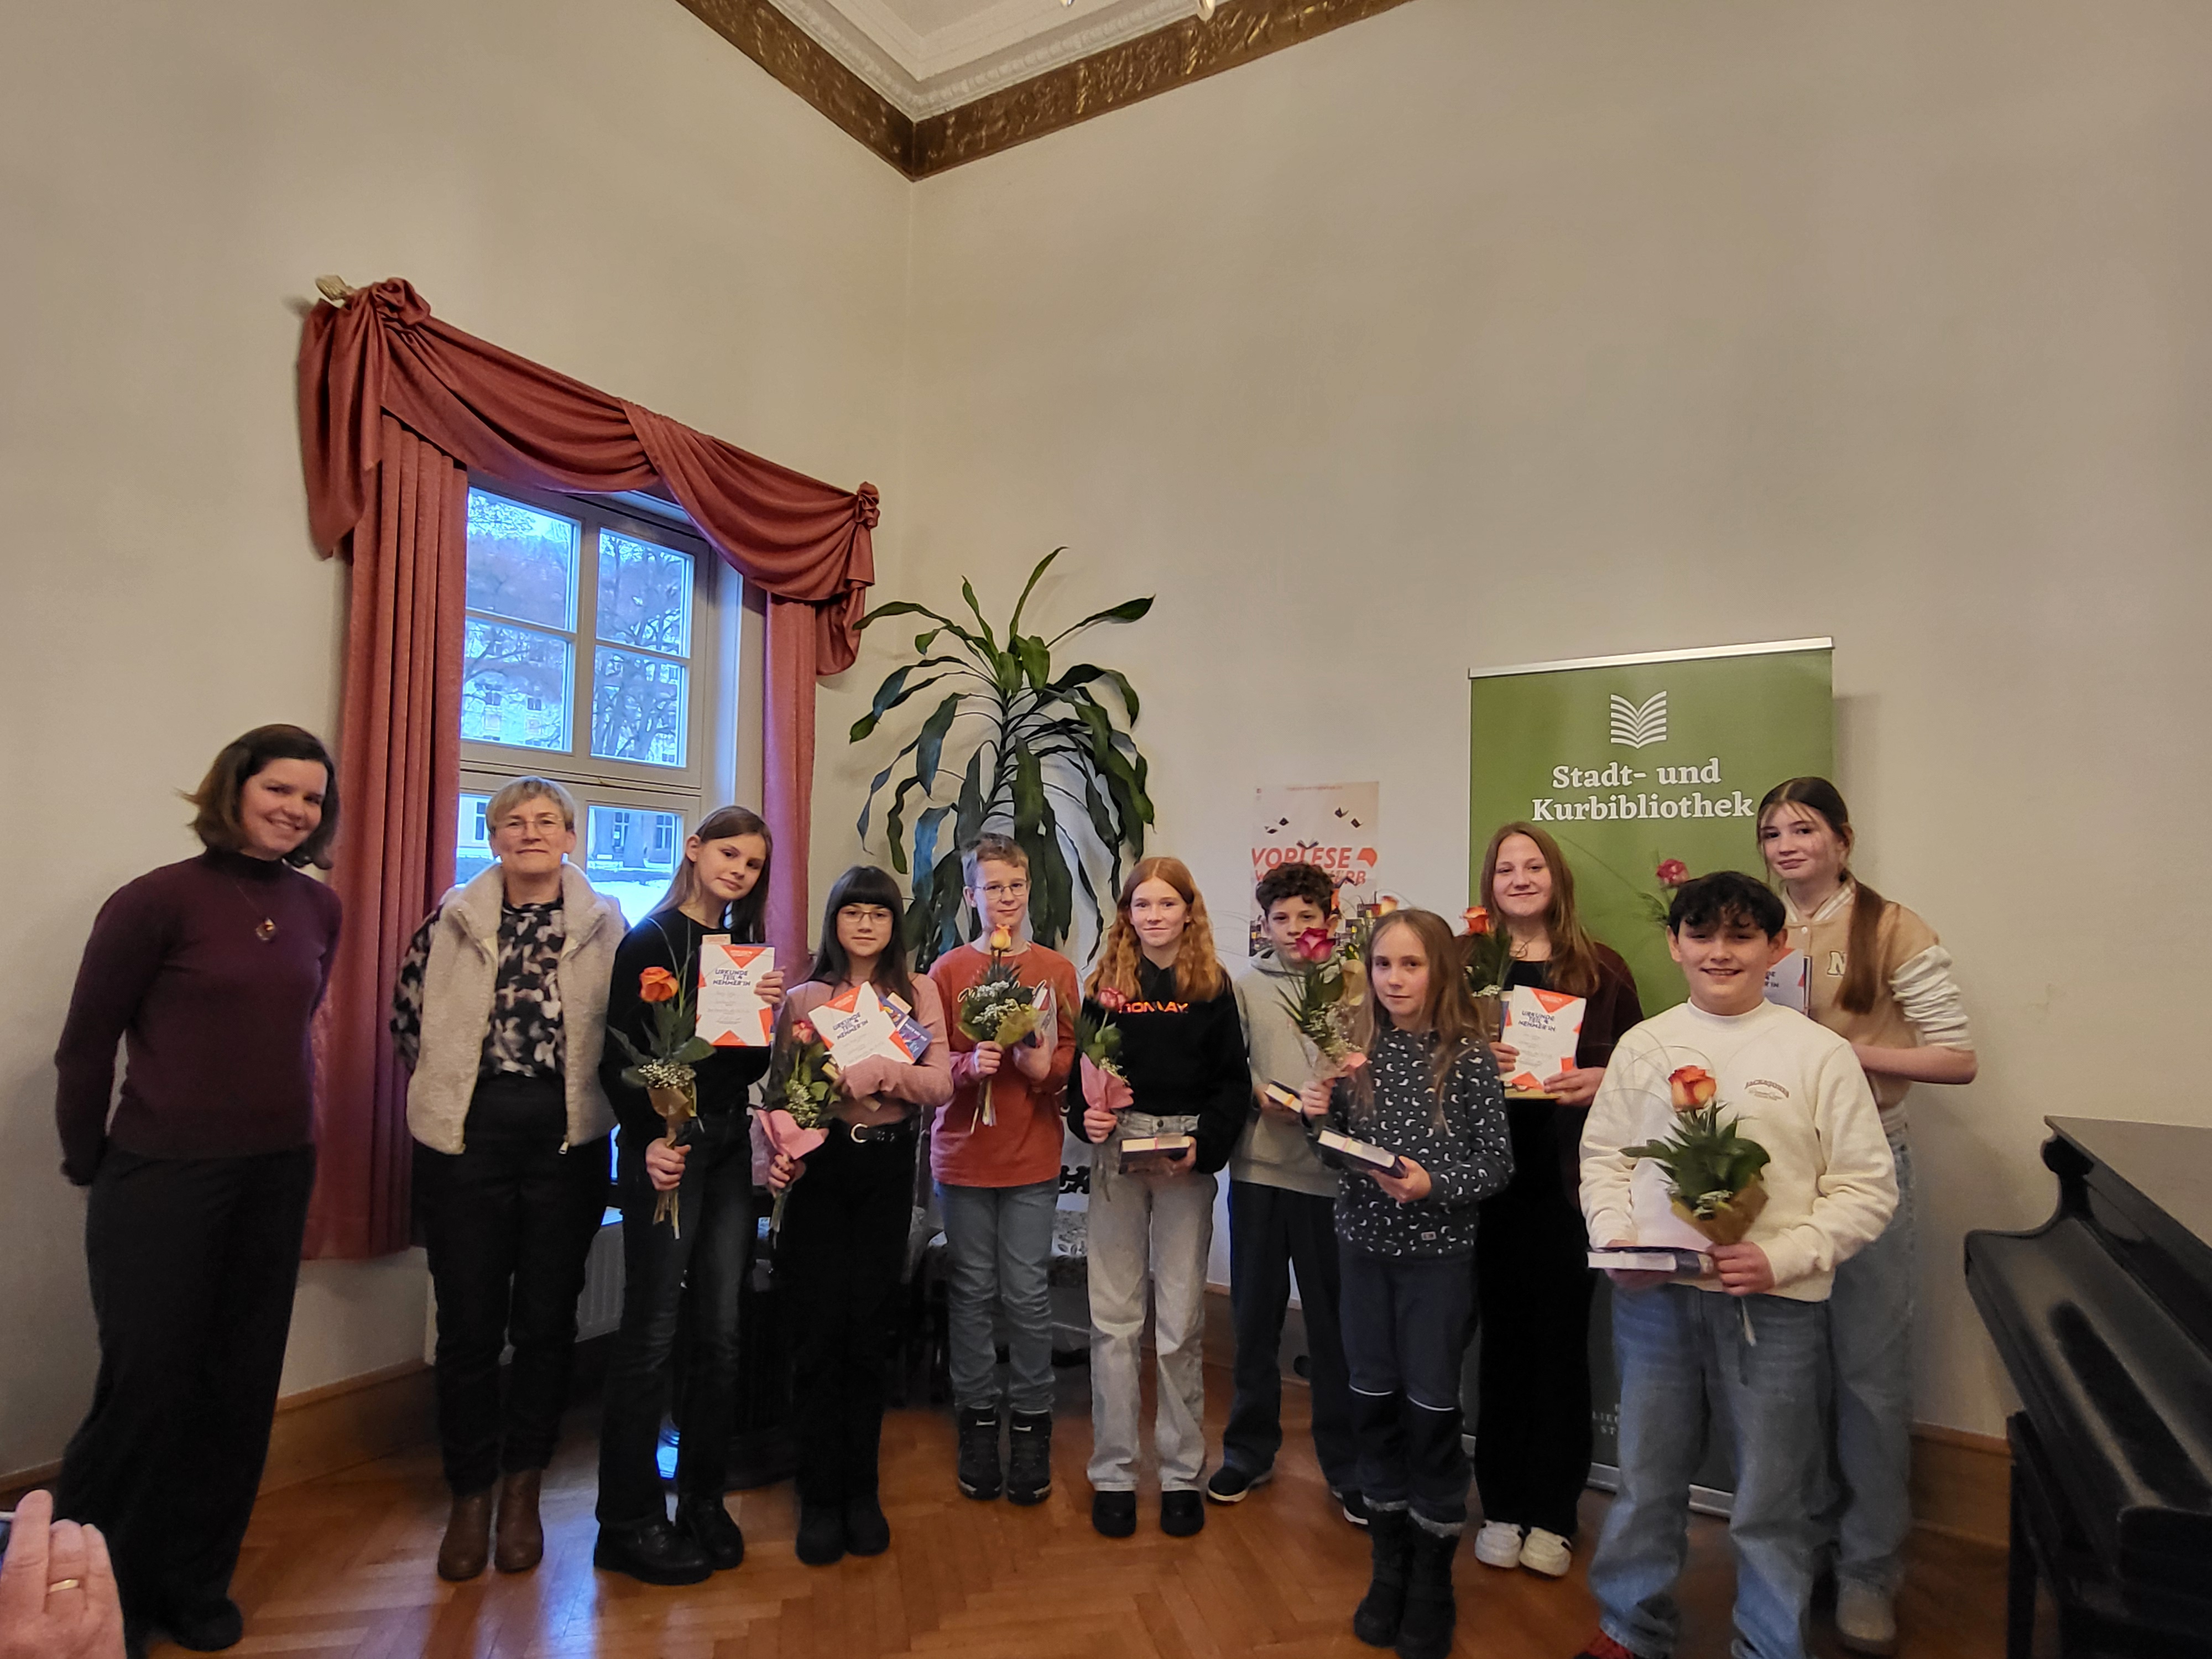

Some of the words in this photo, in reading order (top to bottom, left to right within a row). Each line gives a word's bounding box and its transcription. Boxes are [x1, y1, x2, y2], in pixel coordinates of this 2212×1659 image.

[1552, 761, 1647, 789] Stadt-
[1656, 757, 1721, 785] und
[1531, 791, 1755, 822] Kurbibliothek
[833, 1011, 861, 1030] URKUNDE
[1522, 1010, 1554, 1021] URKUNDE
